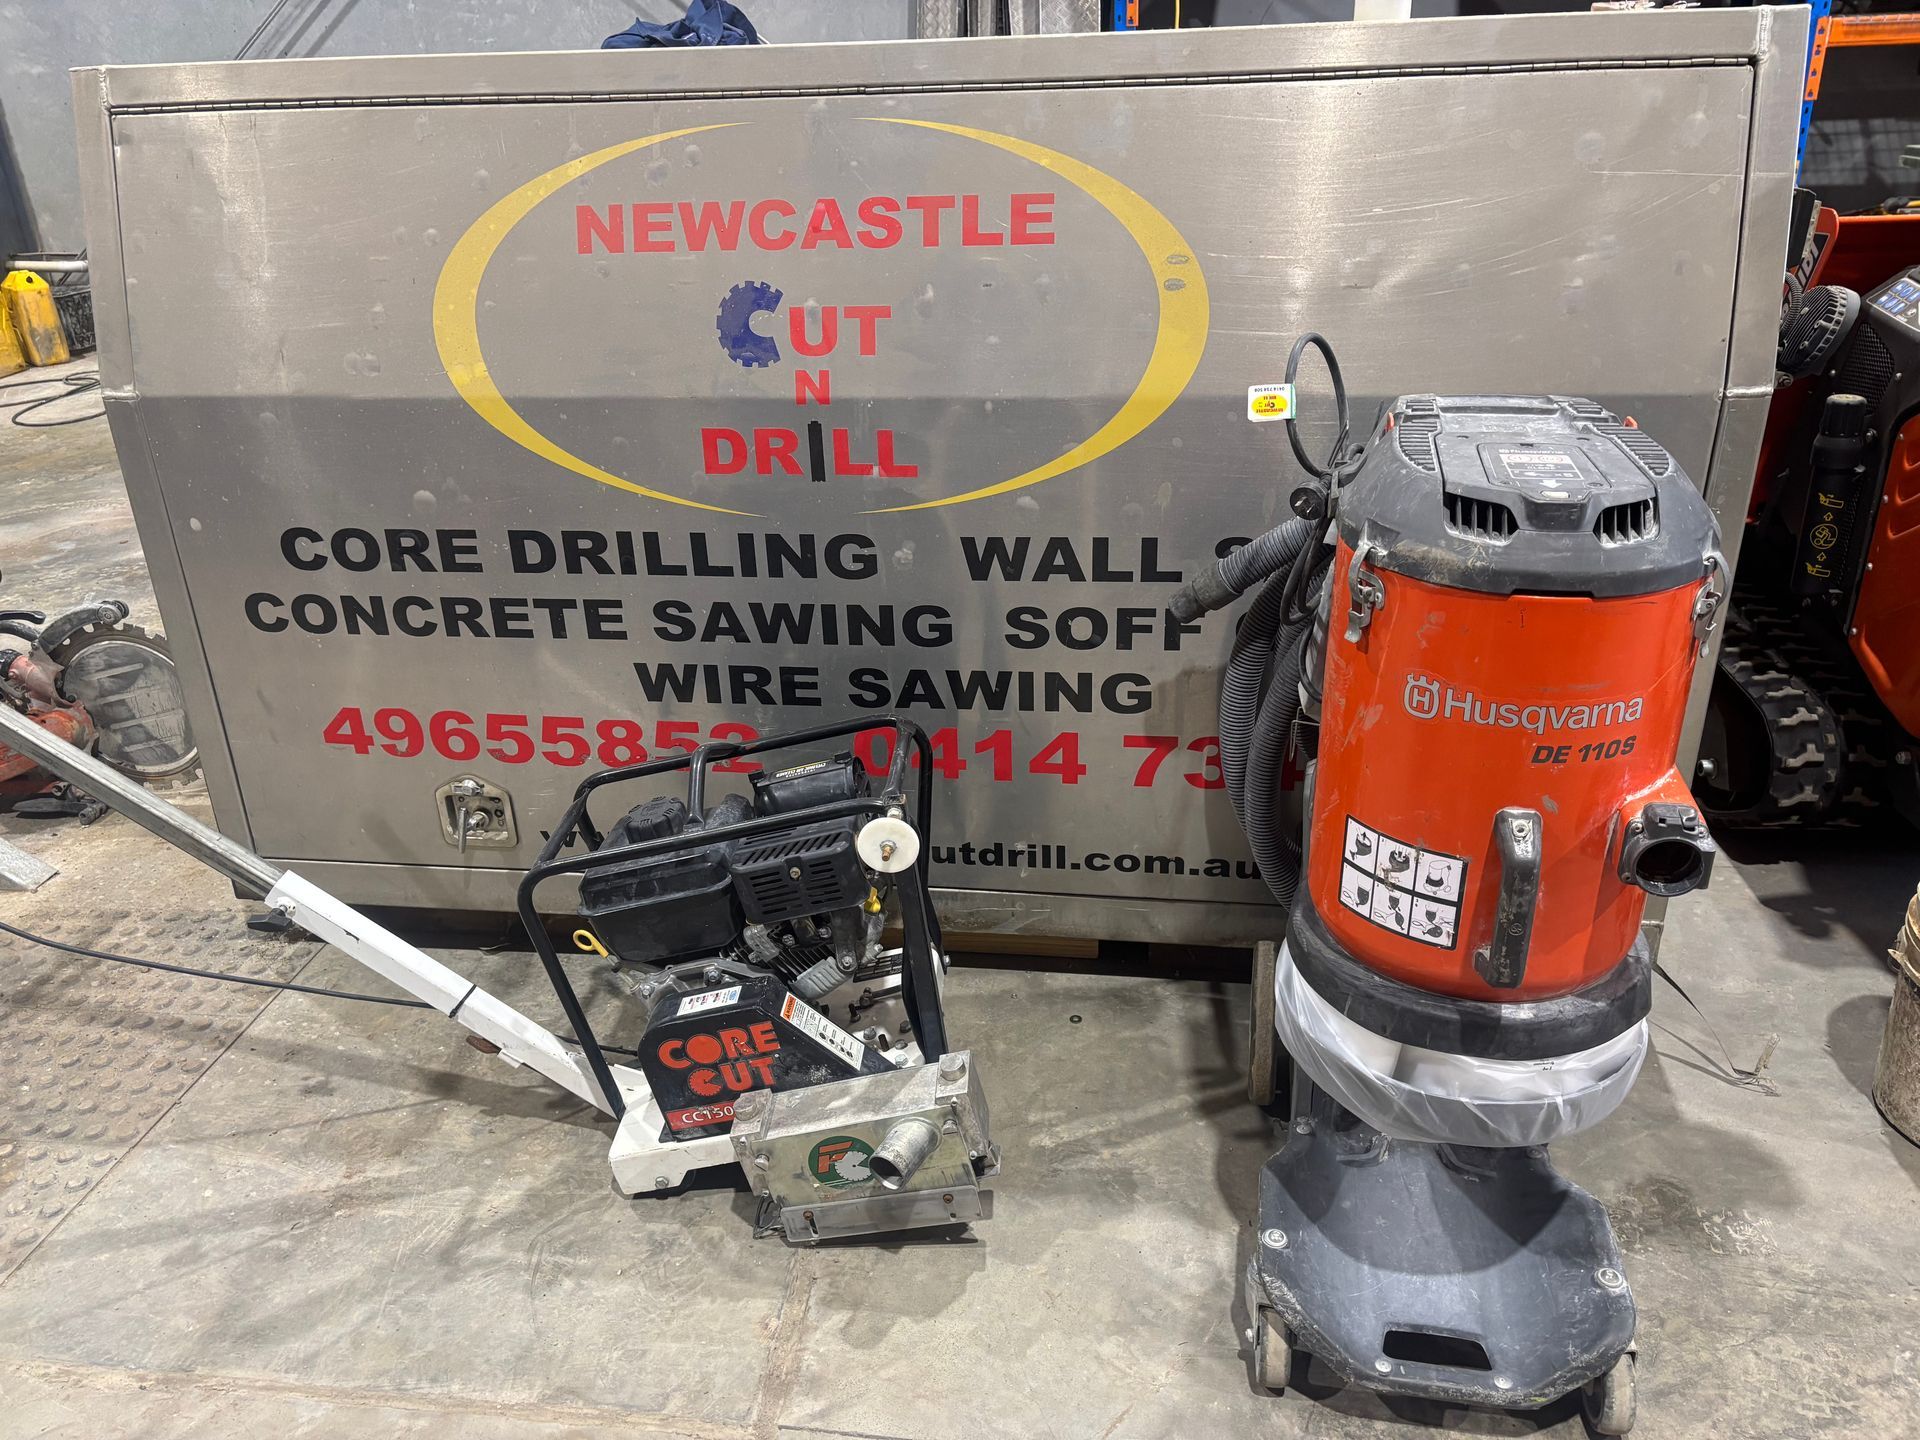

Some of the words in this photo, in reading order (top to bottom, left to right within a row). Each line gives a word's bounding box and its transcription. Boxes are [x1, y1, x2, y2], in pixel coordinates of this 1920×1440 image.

[575, 193, 1055, 254] NEWCASTLE
[716, 280, 891, 368] CUT
[795, 369, 831, 406] N
[701, 421, 918, 482] DRILL
[280, 527, 483, 573] CORE
[507, 529, 878, 579] DRILLING
[960, 536, 1183, 583] WALL
[244, 592, 628, 640] CONCRETE
[652, 599, 953, 648] SAWING
[633, 662, 822, 706] WIRE
[848, 667, 1153, 714] SAWING
[1444, 688, 1643, 735] Husqvarna
[323, 706, 764, 774] 49655852
[853, 726, 1087, 785] 0414
[1531, 745, 1572, 764] DE
[1578, 735, 1637, 763] 110S
[658, 1020, 780, 1069] CORE
